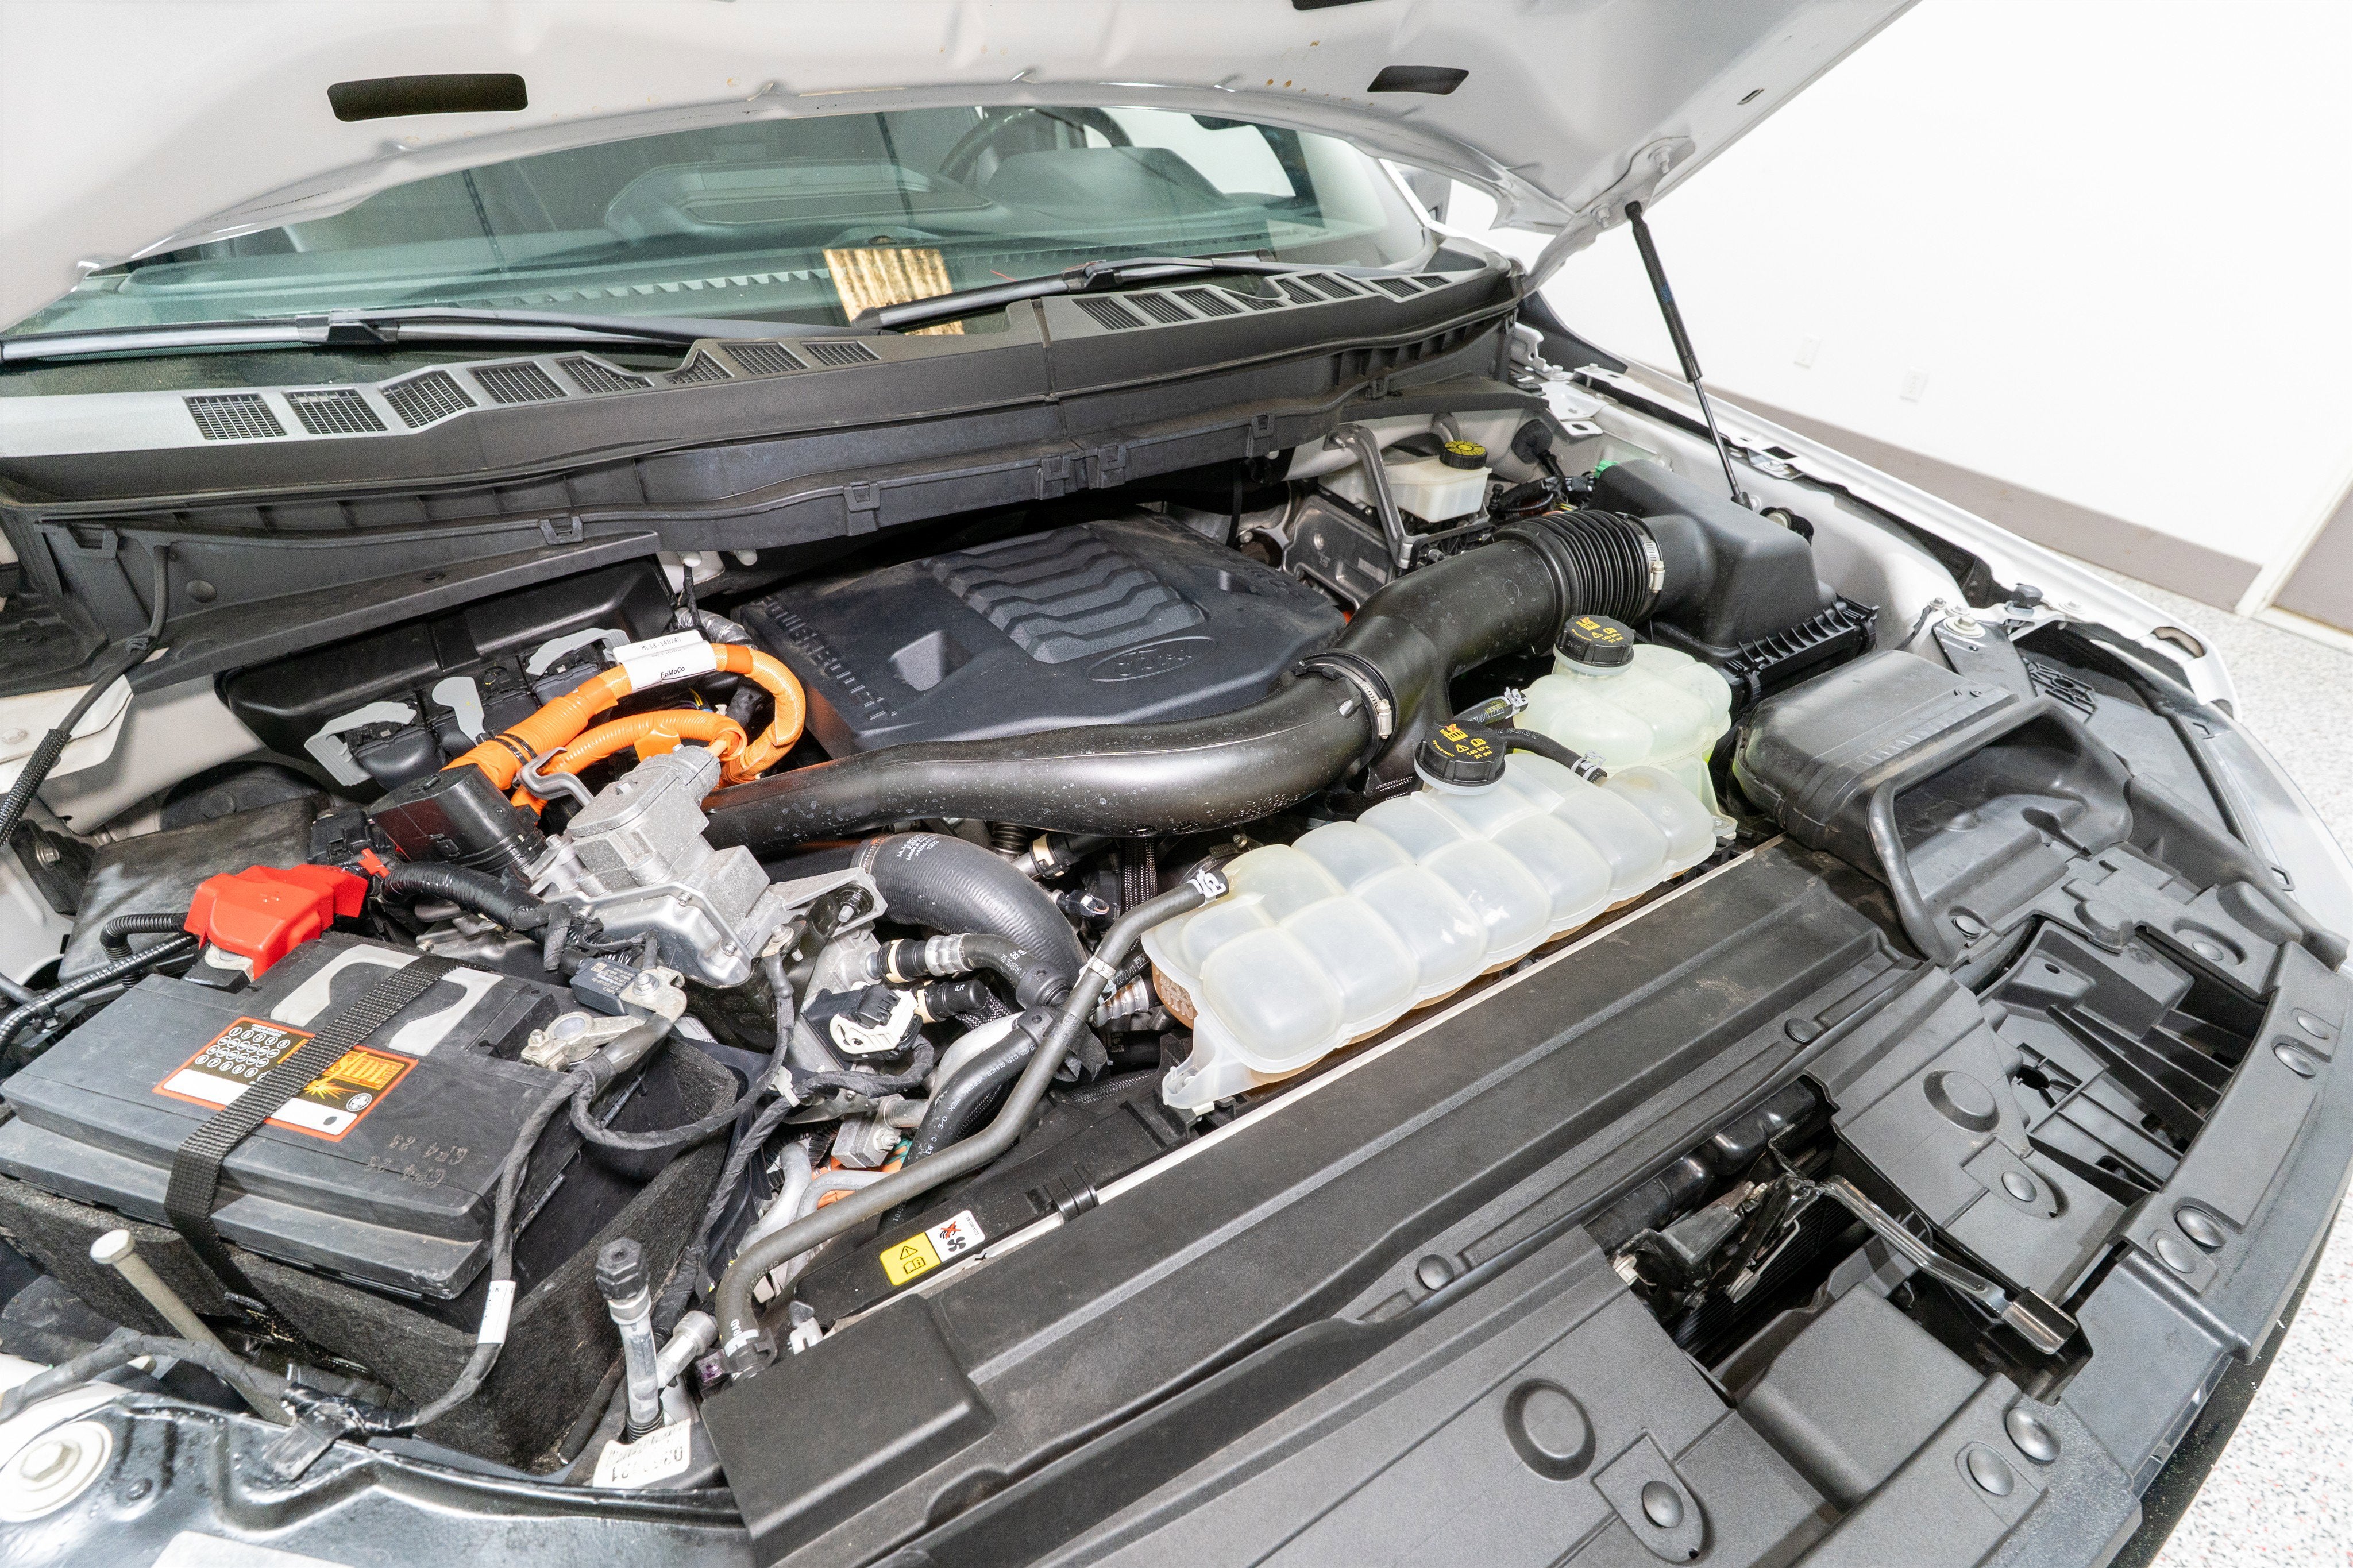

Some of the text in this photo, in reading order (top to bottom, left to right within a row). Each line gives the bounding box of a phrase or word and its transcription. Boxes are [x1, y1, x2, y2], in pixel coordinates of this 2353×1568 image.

[660, 666, 685, 678] FoMoCo
[1021, 1044, 1037, 1056] 8/22
[1008, 1054, 1019, 1064] CIP
[948, 1097, 961, 1112] MEX
[730, 1319, 742, 1337] RAD
